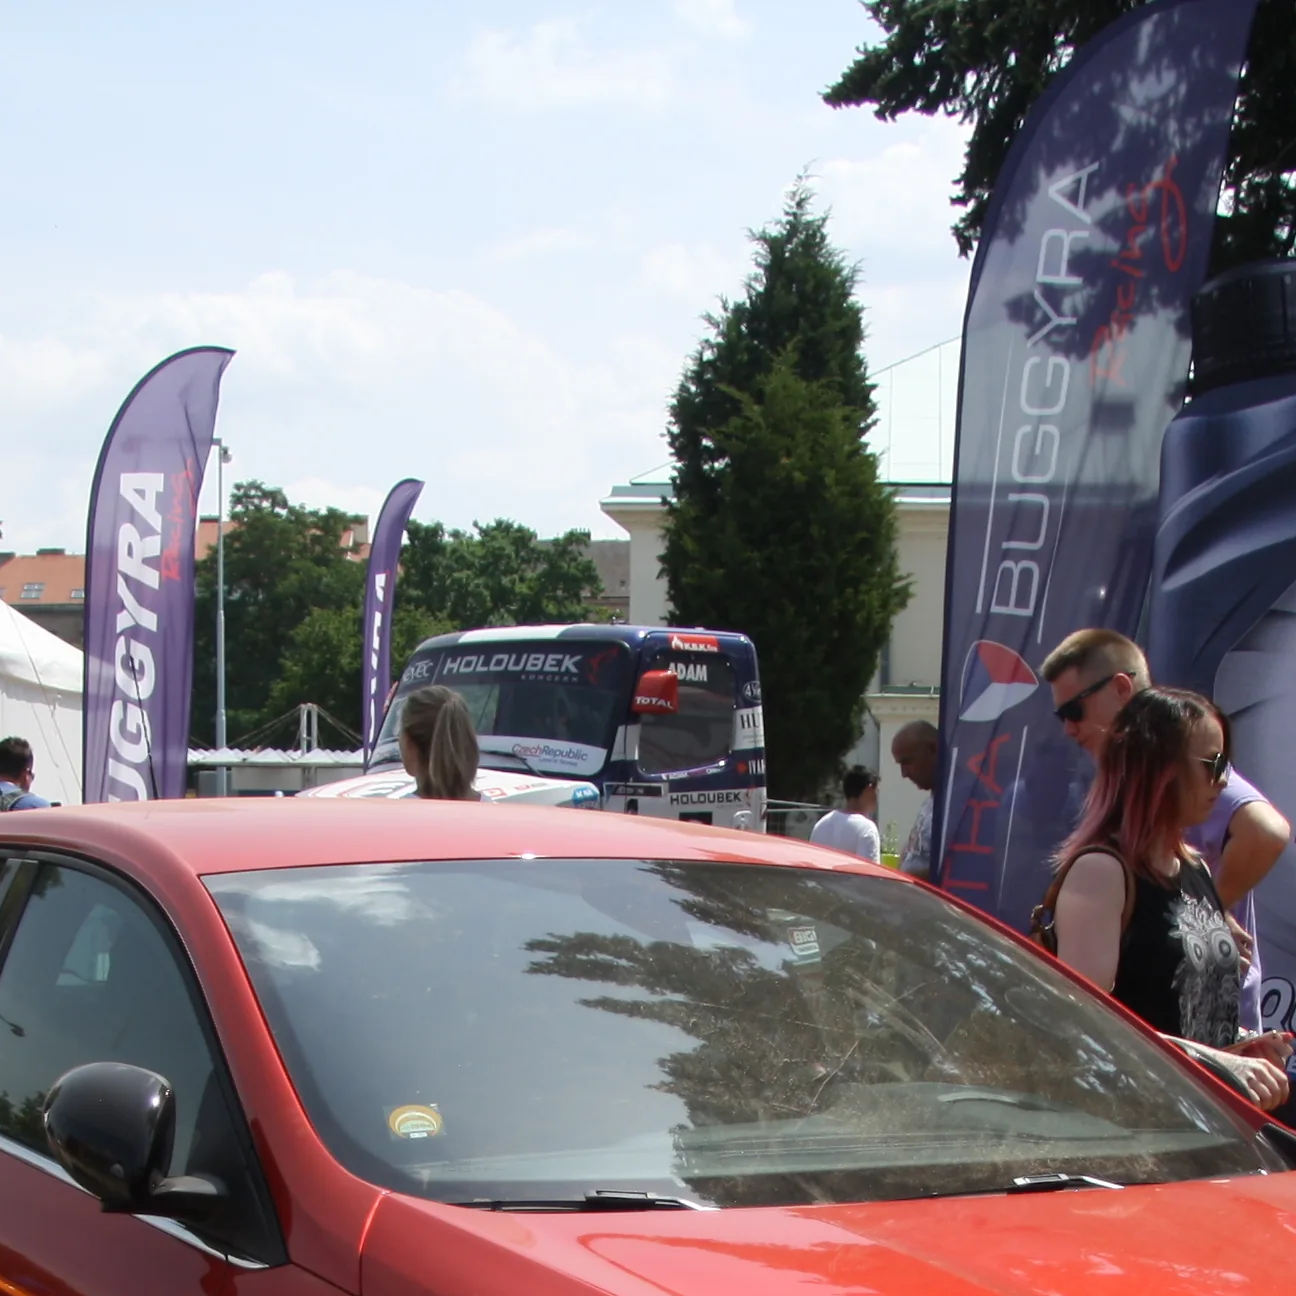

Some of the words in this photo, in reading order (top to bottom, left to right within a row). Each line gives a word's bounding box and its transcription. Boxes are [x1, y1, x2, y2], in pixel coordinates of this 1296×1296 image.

[989, 161, 1100, 617] BUGGYRA
[106, 472, 165, 802] UGGYRA
[442, 652, 584, 676] HOLOUBEK
[669, 661, 708, 682] ADAM
[635, 696, 675, 710] TOTAL
[669, 791, 742, 806] HOLOUBEK
